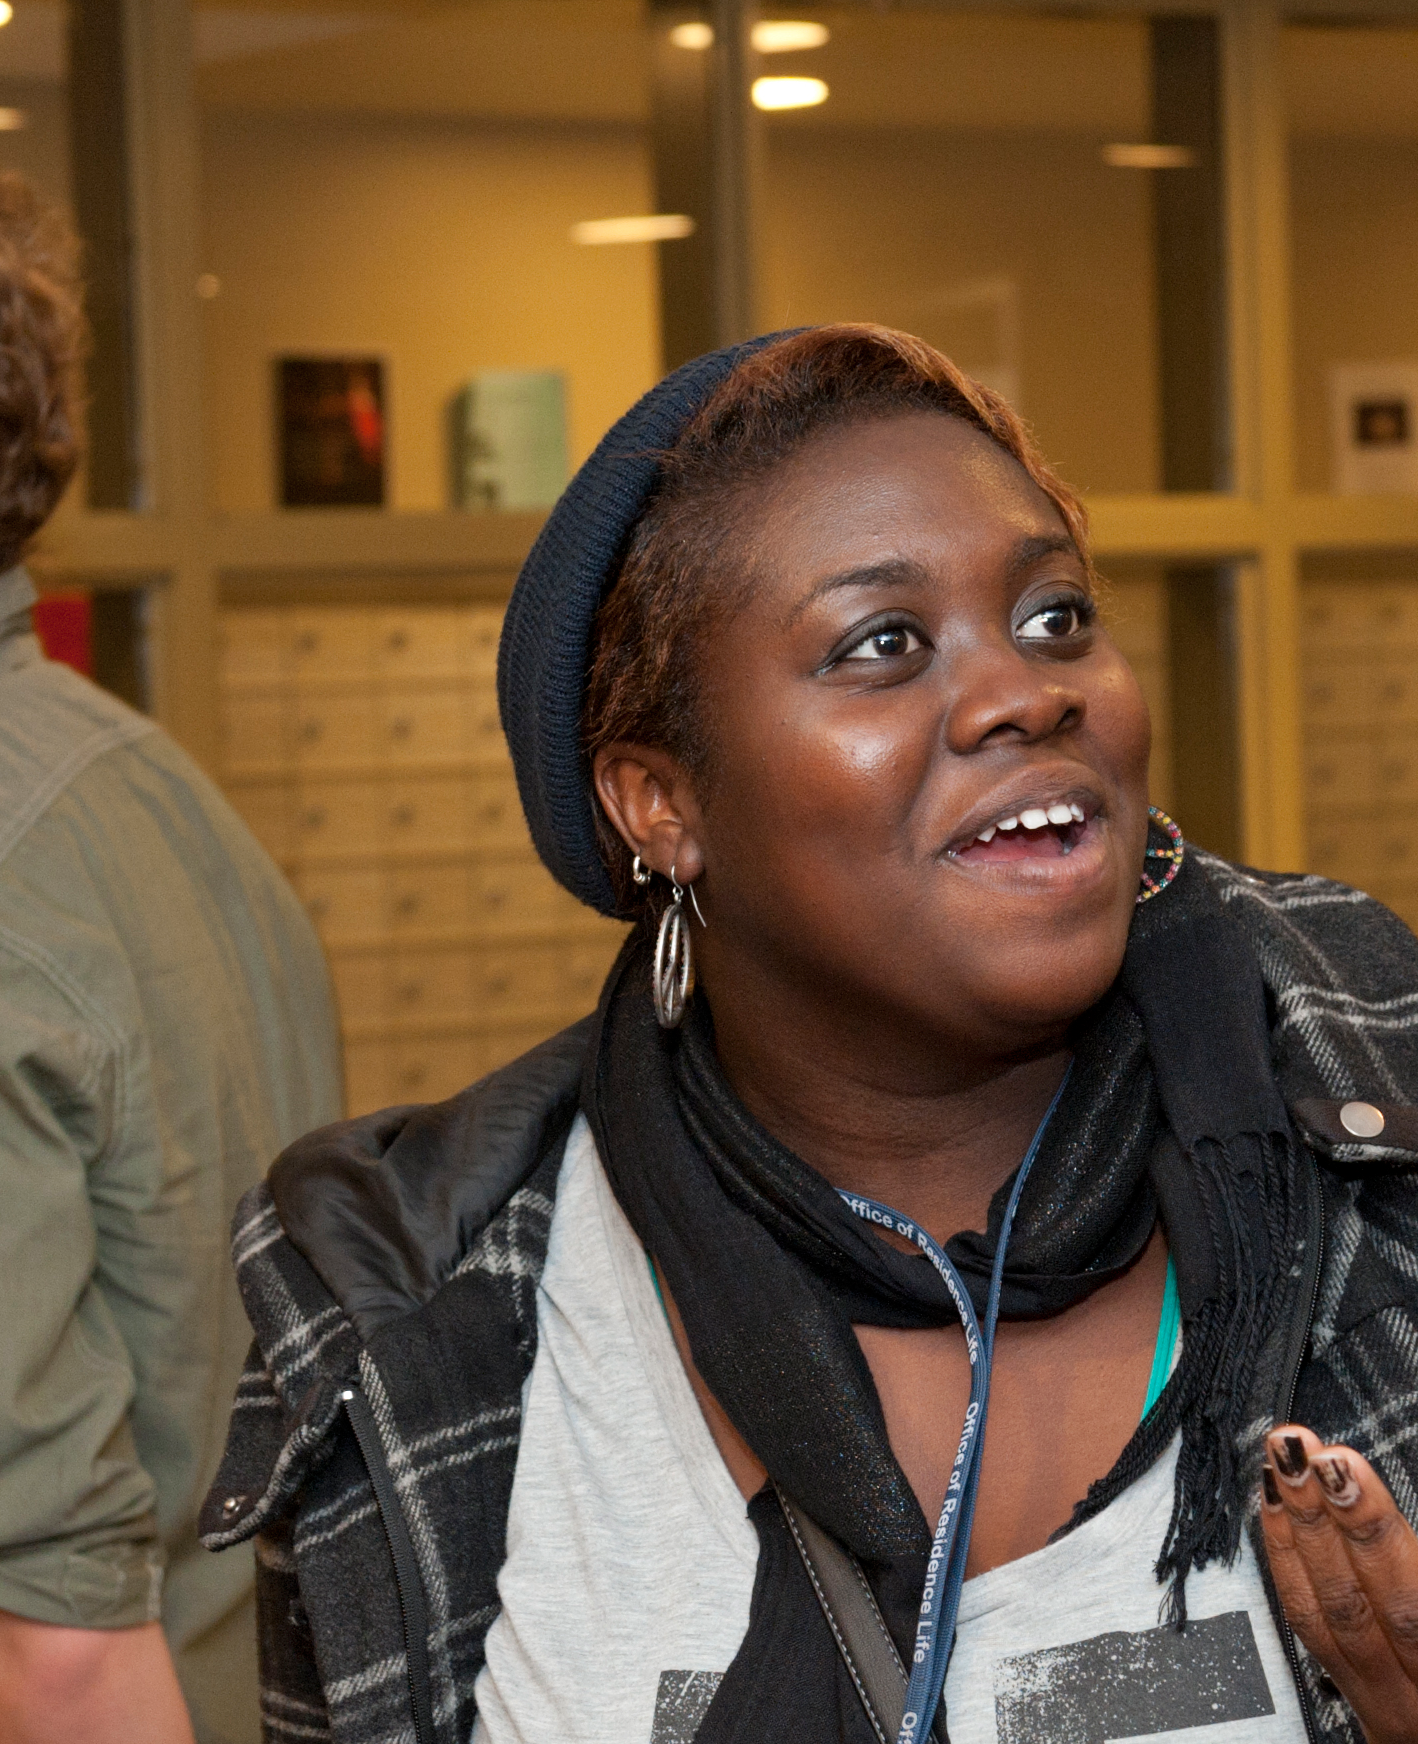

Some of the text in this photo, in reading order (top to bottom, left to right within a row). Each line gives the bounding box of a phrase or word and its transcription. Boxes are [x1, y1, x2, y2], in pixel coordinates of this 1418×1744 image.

[897, 1223, 914, 1239] of
[917, 1232, 968, 1326] Residence
[965, 1323, 979, 1365] Life
[913, 1401, 980, 1663] Office of Residence Life
